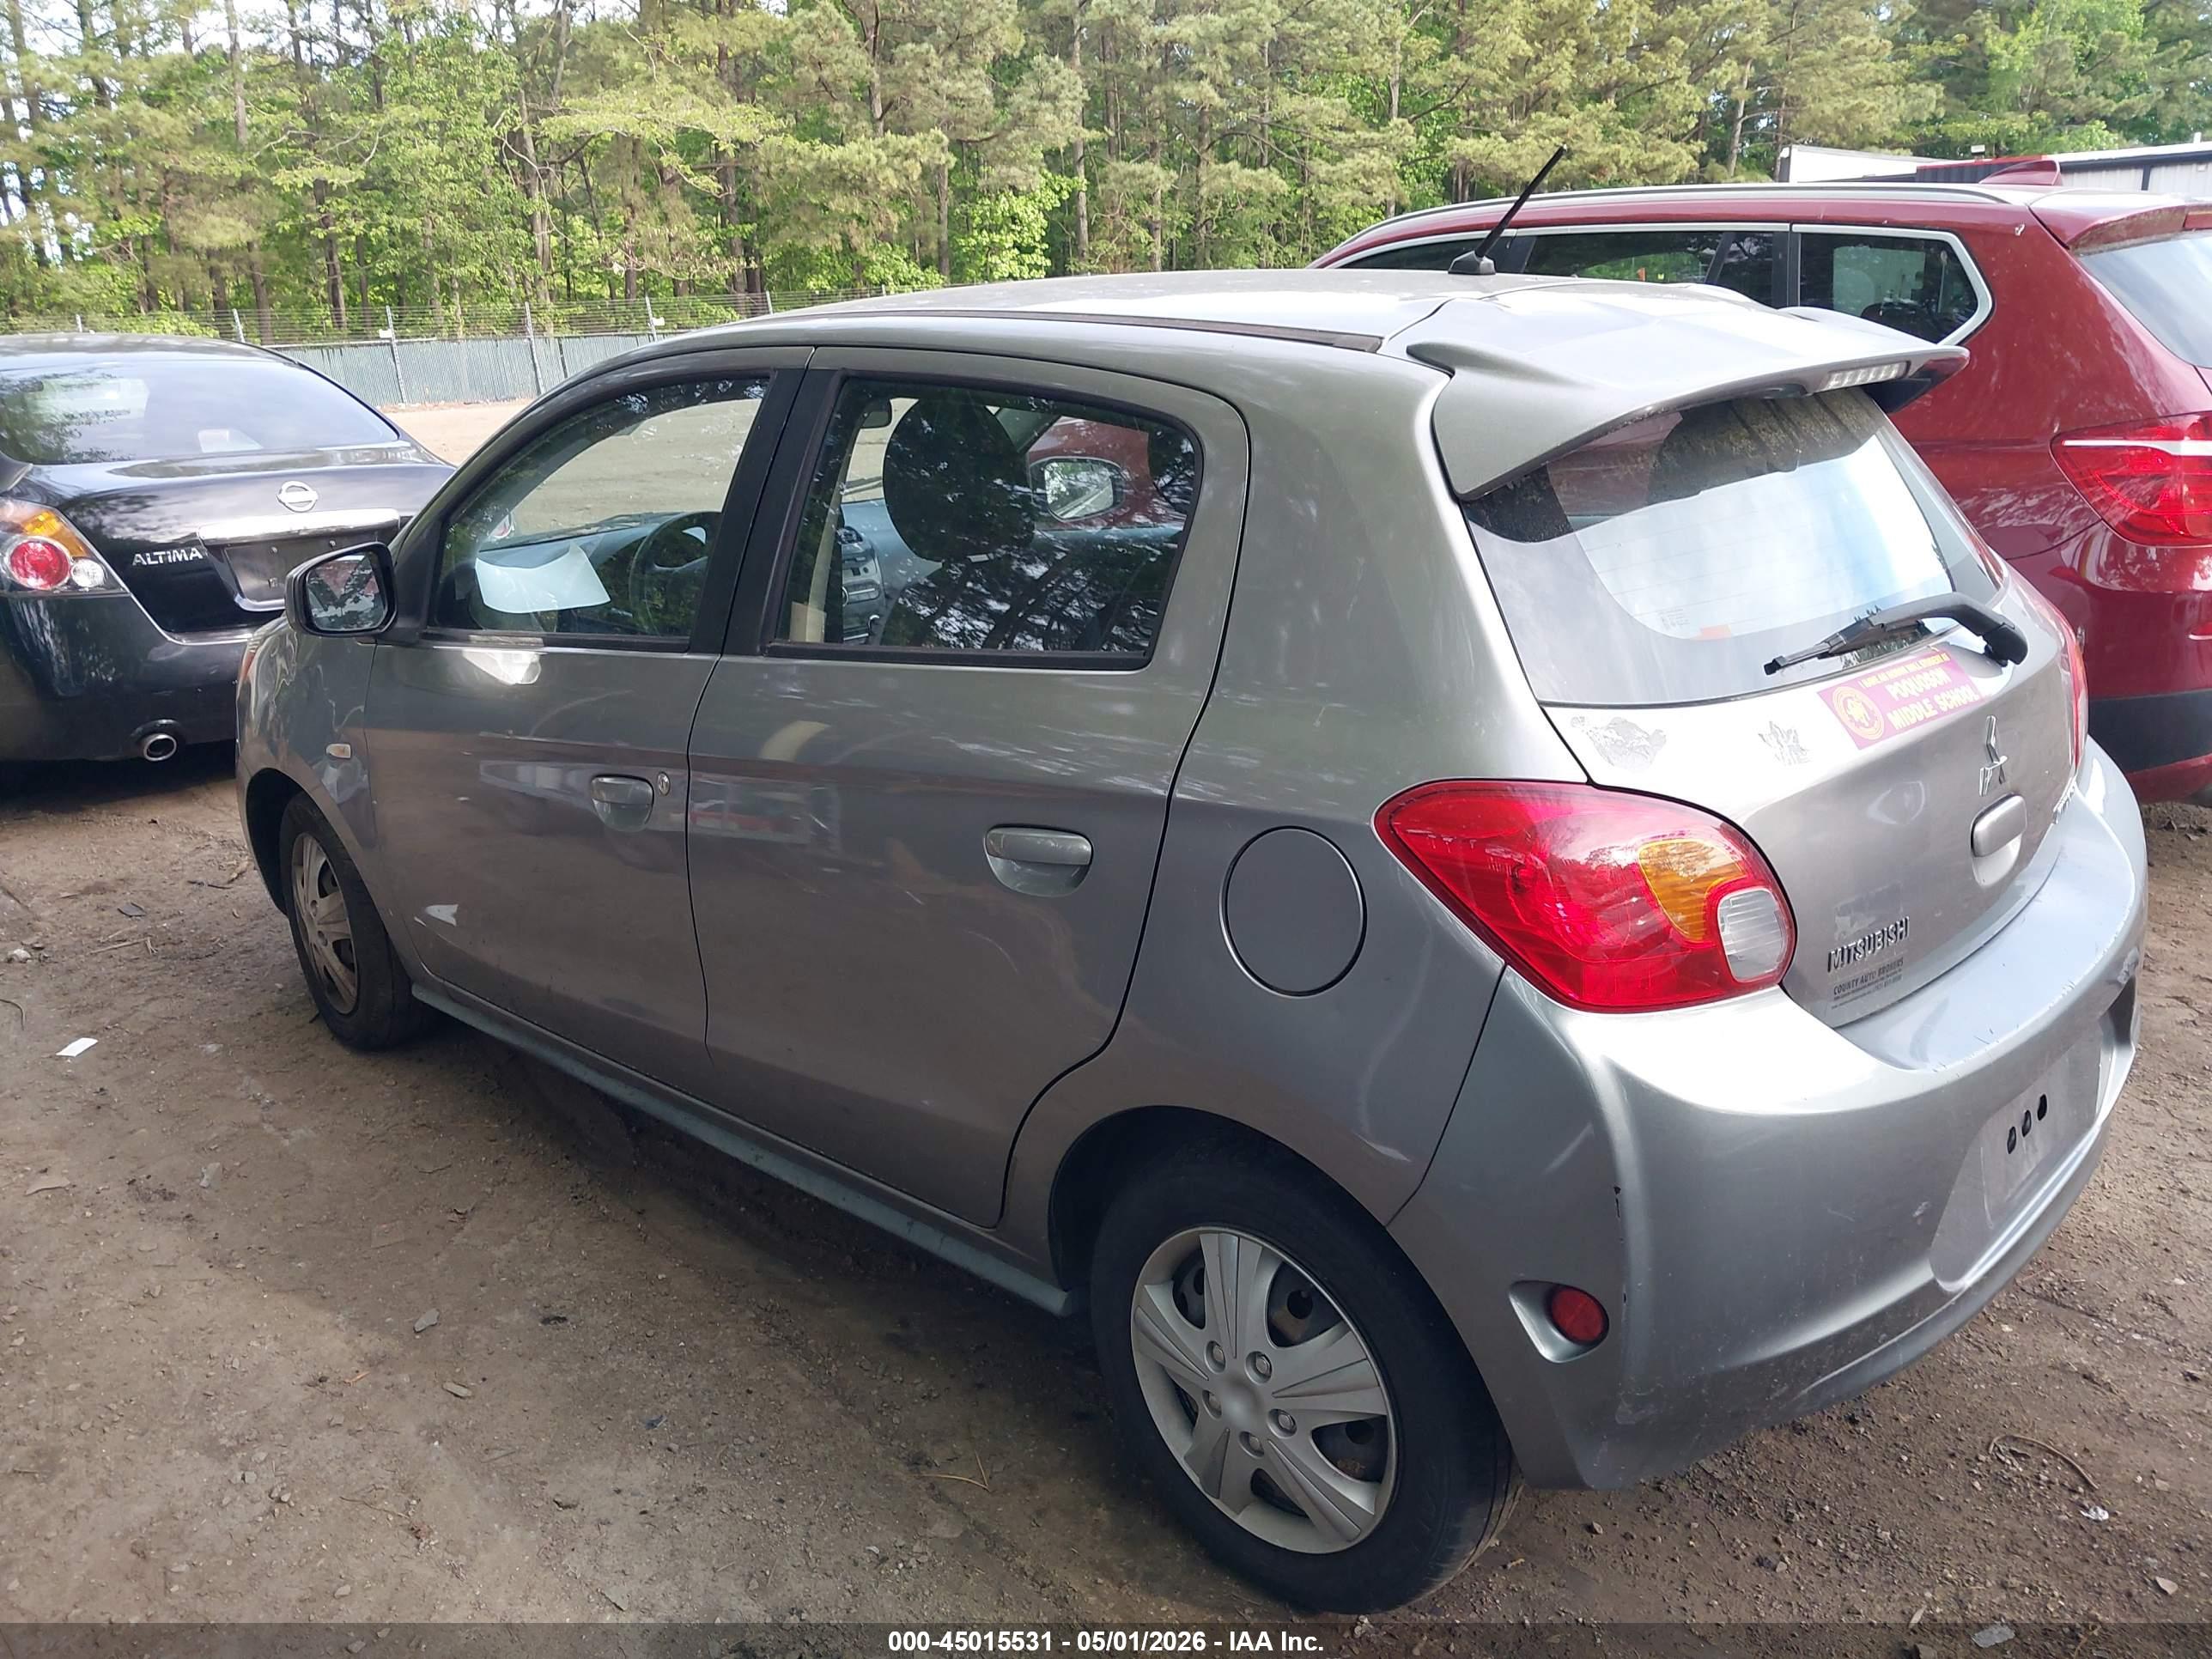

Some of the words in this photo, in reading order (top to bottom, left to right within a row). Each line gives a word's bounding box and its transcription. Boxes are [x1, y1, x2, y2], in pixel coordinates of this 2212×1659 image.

[132, 547, 203, 566] ALTIMA
[1887, 697, 1938, 730] MIDDLE
[1934, 684, 1980, 712] SCHOOL
[1826, 915, 1910, 974] MITSUBISHI
